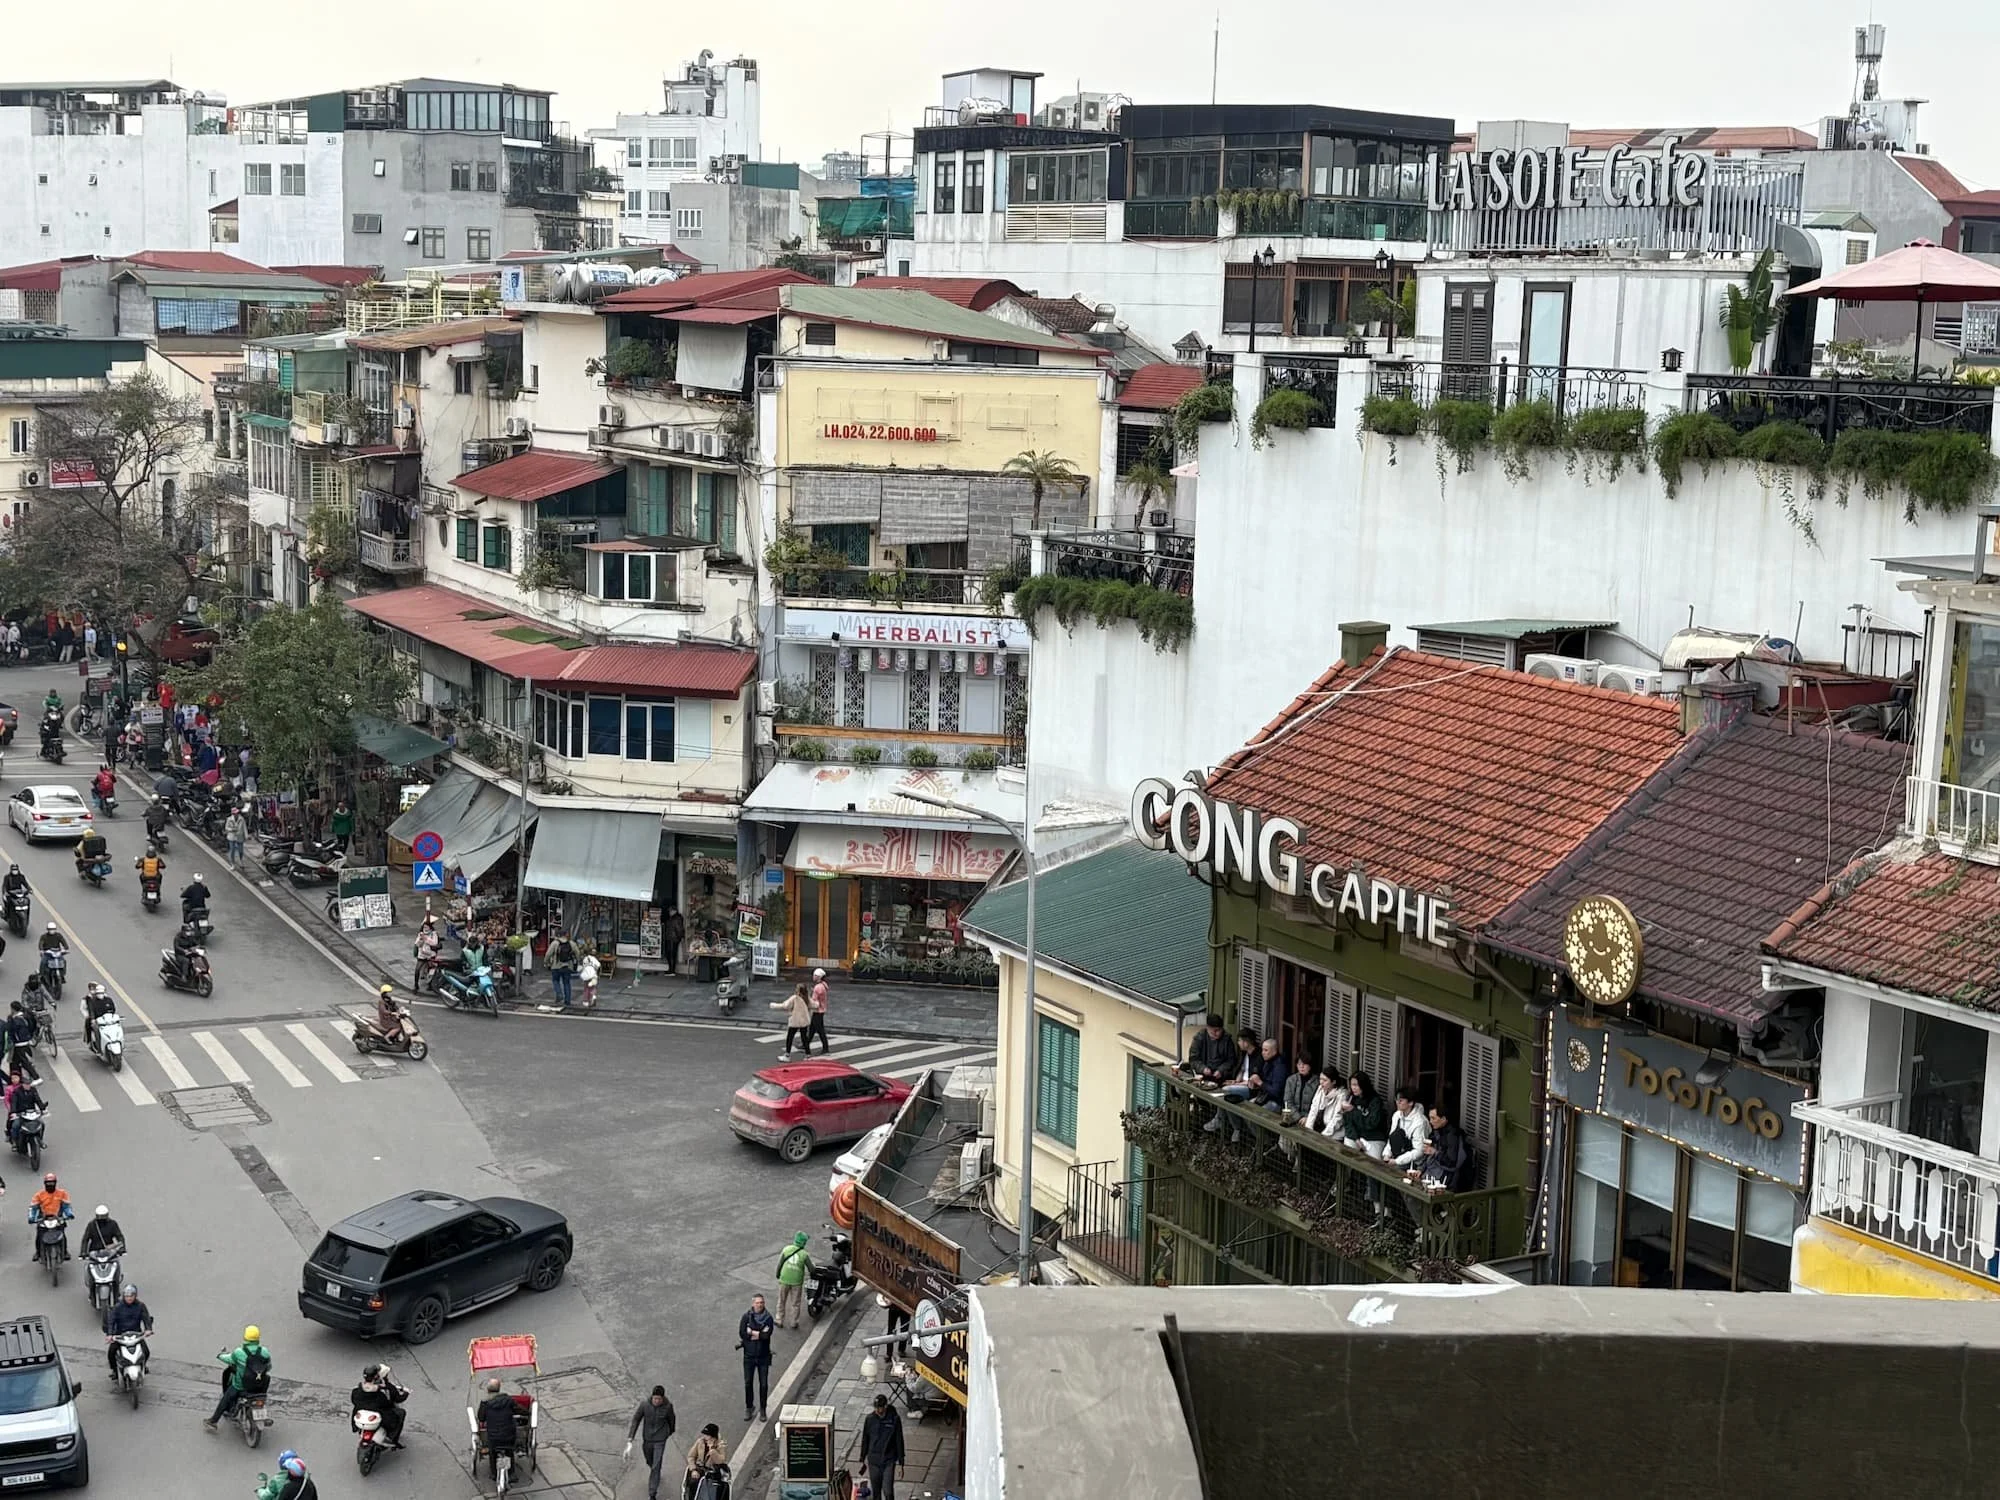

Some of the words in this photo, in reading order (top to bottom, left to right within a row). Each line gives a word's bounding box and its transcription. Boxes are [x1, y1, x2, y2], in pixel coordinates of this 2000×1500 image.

[1428, 151, 1477, 211] LA
[1486, 143, 1590, 211] SOIE
[1601, 136, 1705, 208] Cafe
[858, 625, 992, 644] HERBALIST
